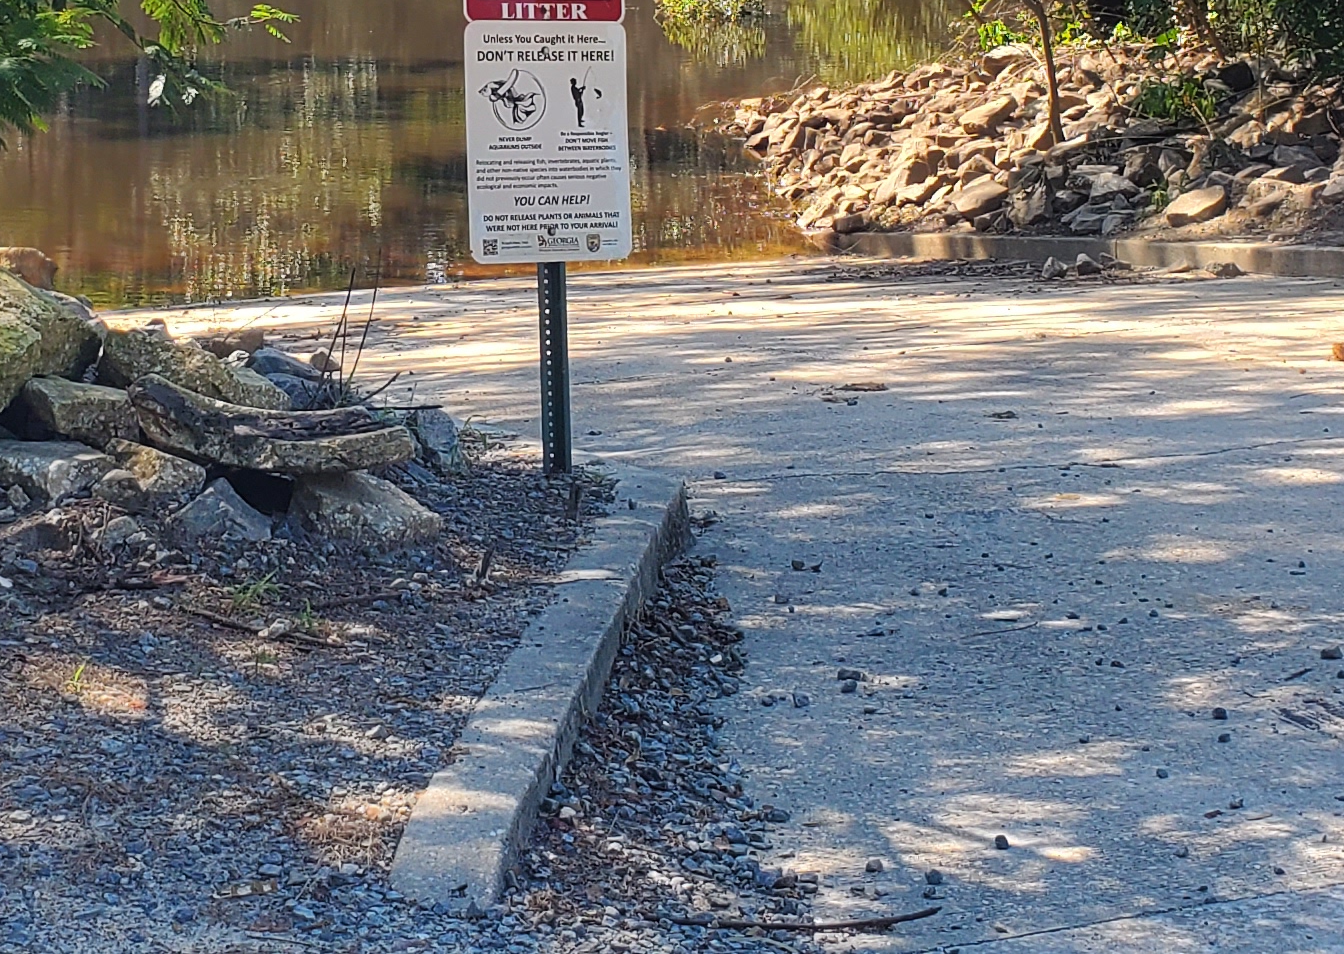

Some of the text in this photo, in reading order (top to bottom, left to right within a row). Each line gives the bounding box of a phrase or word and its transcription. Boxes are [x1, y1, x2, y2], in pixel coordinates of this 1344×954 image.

[501, 3, 588, 20] LITTER
[483, 34, 513, 43] Unless
[515, 35, 532, 43] You
[534, 34, 565, 45] Caught
[568, 34, 574, 43] it
[477, 50, 614, 61] DON'T RELEASE IT HERE!
[514, 194, 590, 207] YOU CAN HELP!
[547, 237, 579, 246] GEORGIA
